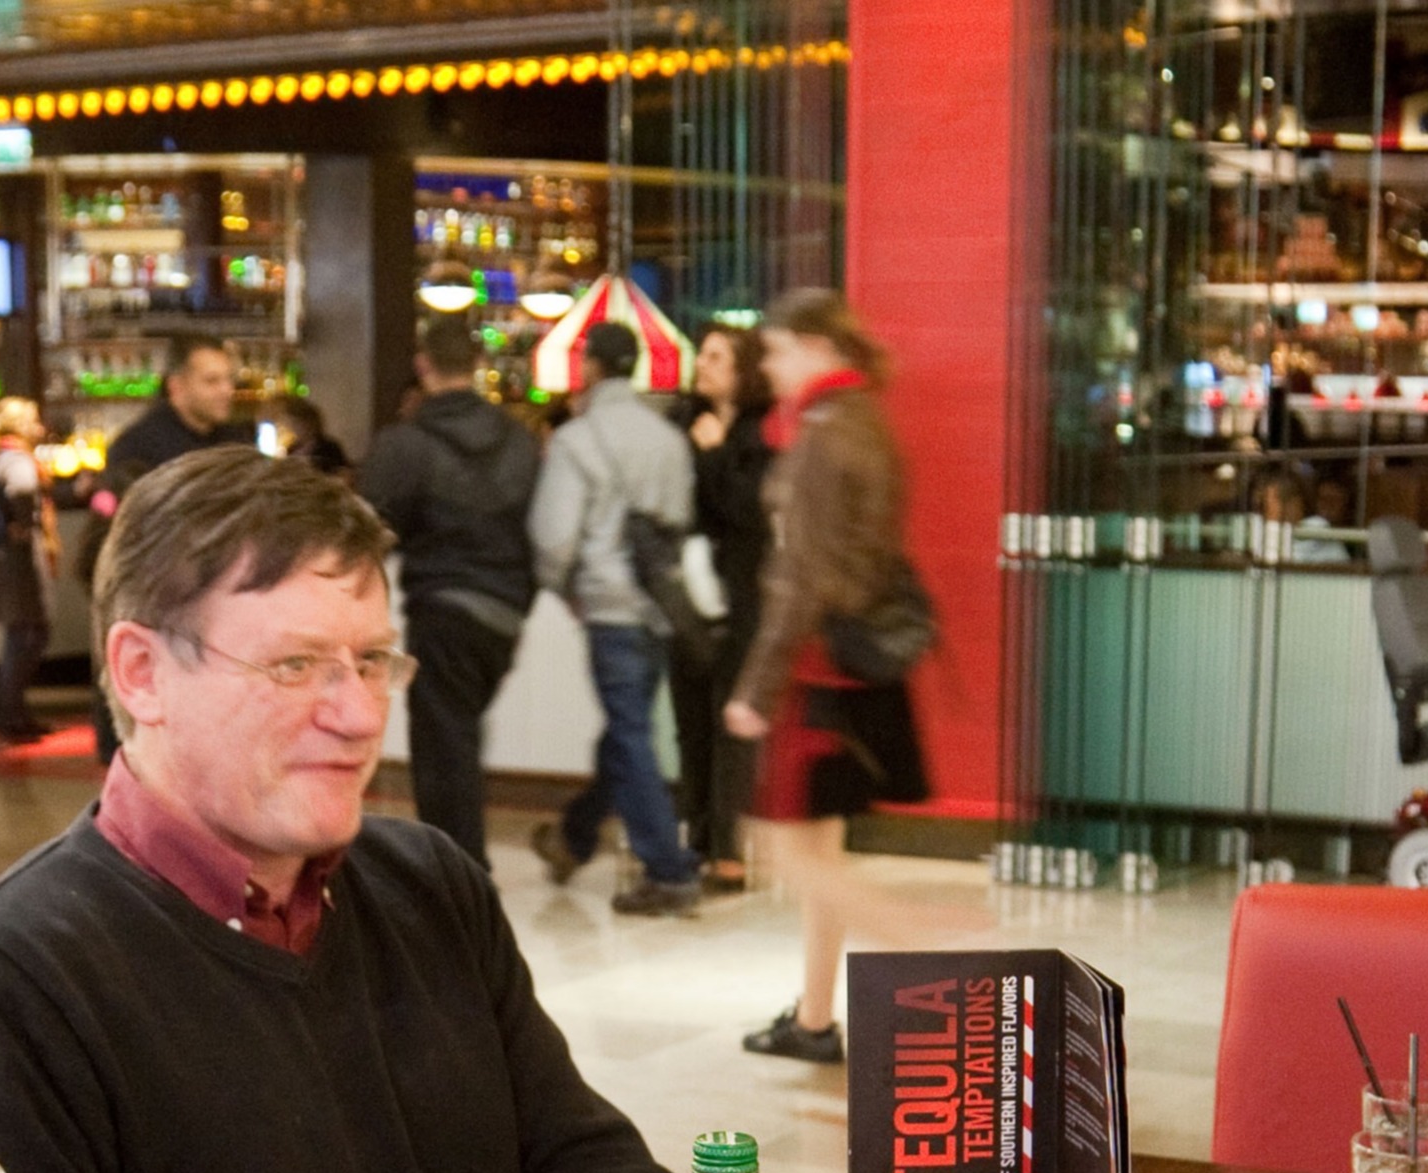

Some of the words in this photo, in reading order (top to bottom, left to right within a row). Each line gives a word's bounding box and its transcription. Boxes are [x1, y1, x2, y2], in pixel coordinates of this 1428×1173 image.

[1001, 975, 1018, 1033] FLAVORS
[964, 977, 995, 1163] TEMPTATIONS
[1001, 1036, 1017, 1097] INSPIRED
[1000, 1100, 1017, 1167] SOUTHERN
